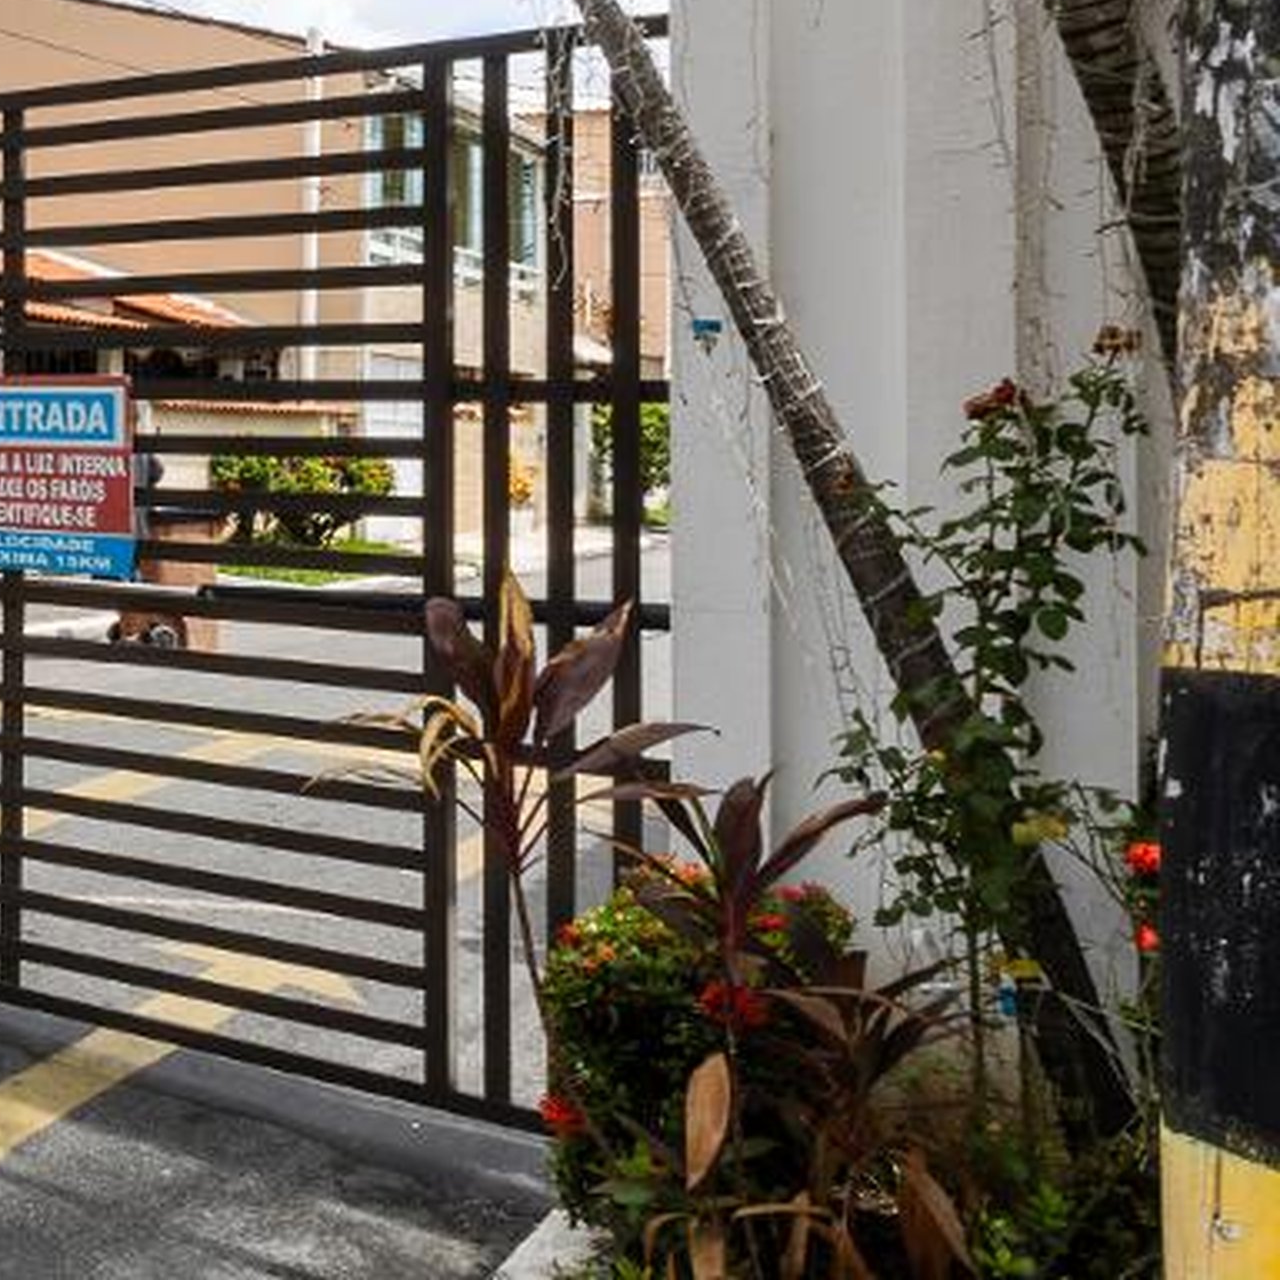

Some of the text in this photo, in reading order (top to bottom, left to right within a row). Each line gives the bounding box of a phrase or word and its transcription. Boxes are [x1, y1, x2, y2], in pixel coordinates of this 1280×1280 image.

[13, 452, 21, 472] A
[26, 452, 54, 474] LUZ
[60, 455, 127, 477] INTERNA
[27, 479, 48, 499] OS
